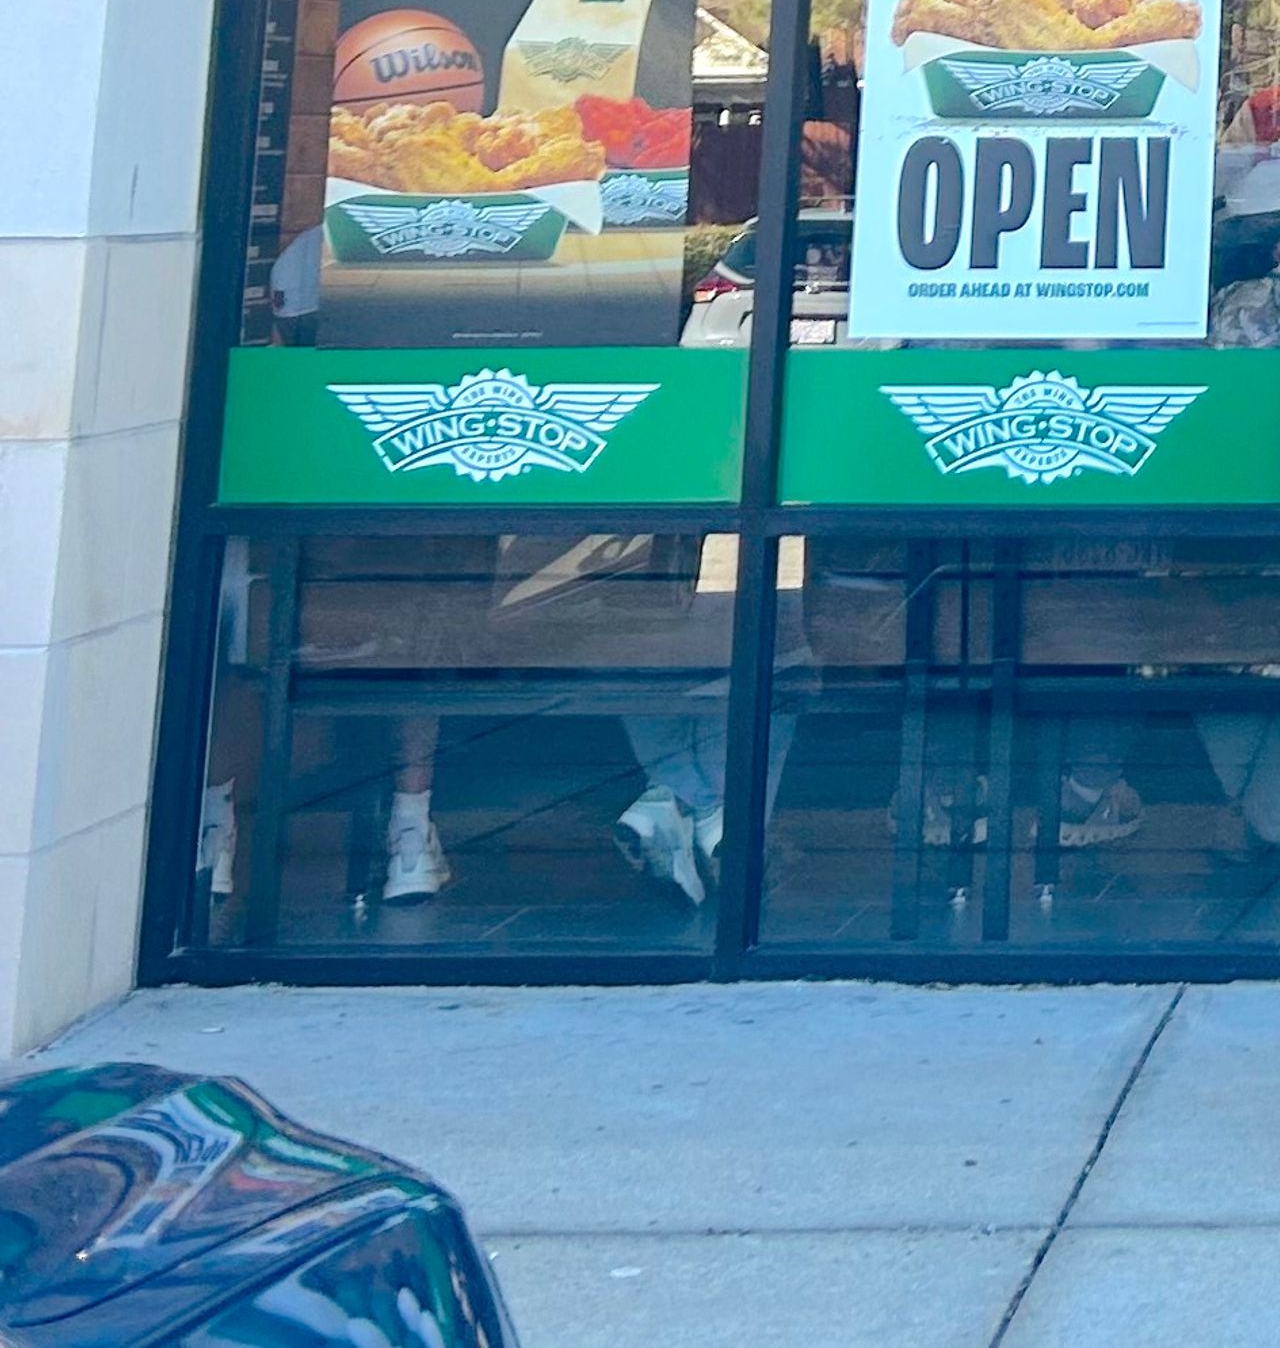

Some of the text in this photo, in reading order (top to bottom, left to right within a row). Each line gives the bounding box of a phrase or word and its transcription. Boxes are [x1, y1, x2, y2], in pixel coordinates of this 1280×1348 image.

[370, 43, 479, 84] Wilson
[896, 134, 1172, 271] OPEN
[908, 281, 1150, 298] ORDER AHEAD AT WINGSTOP.COM
